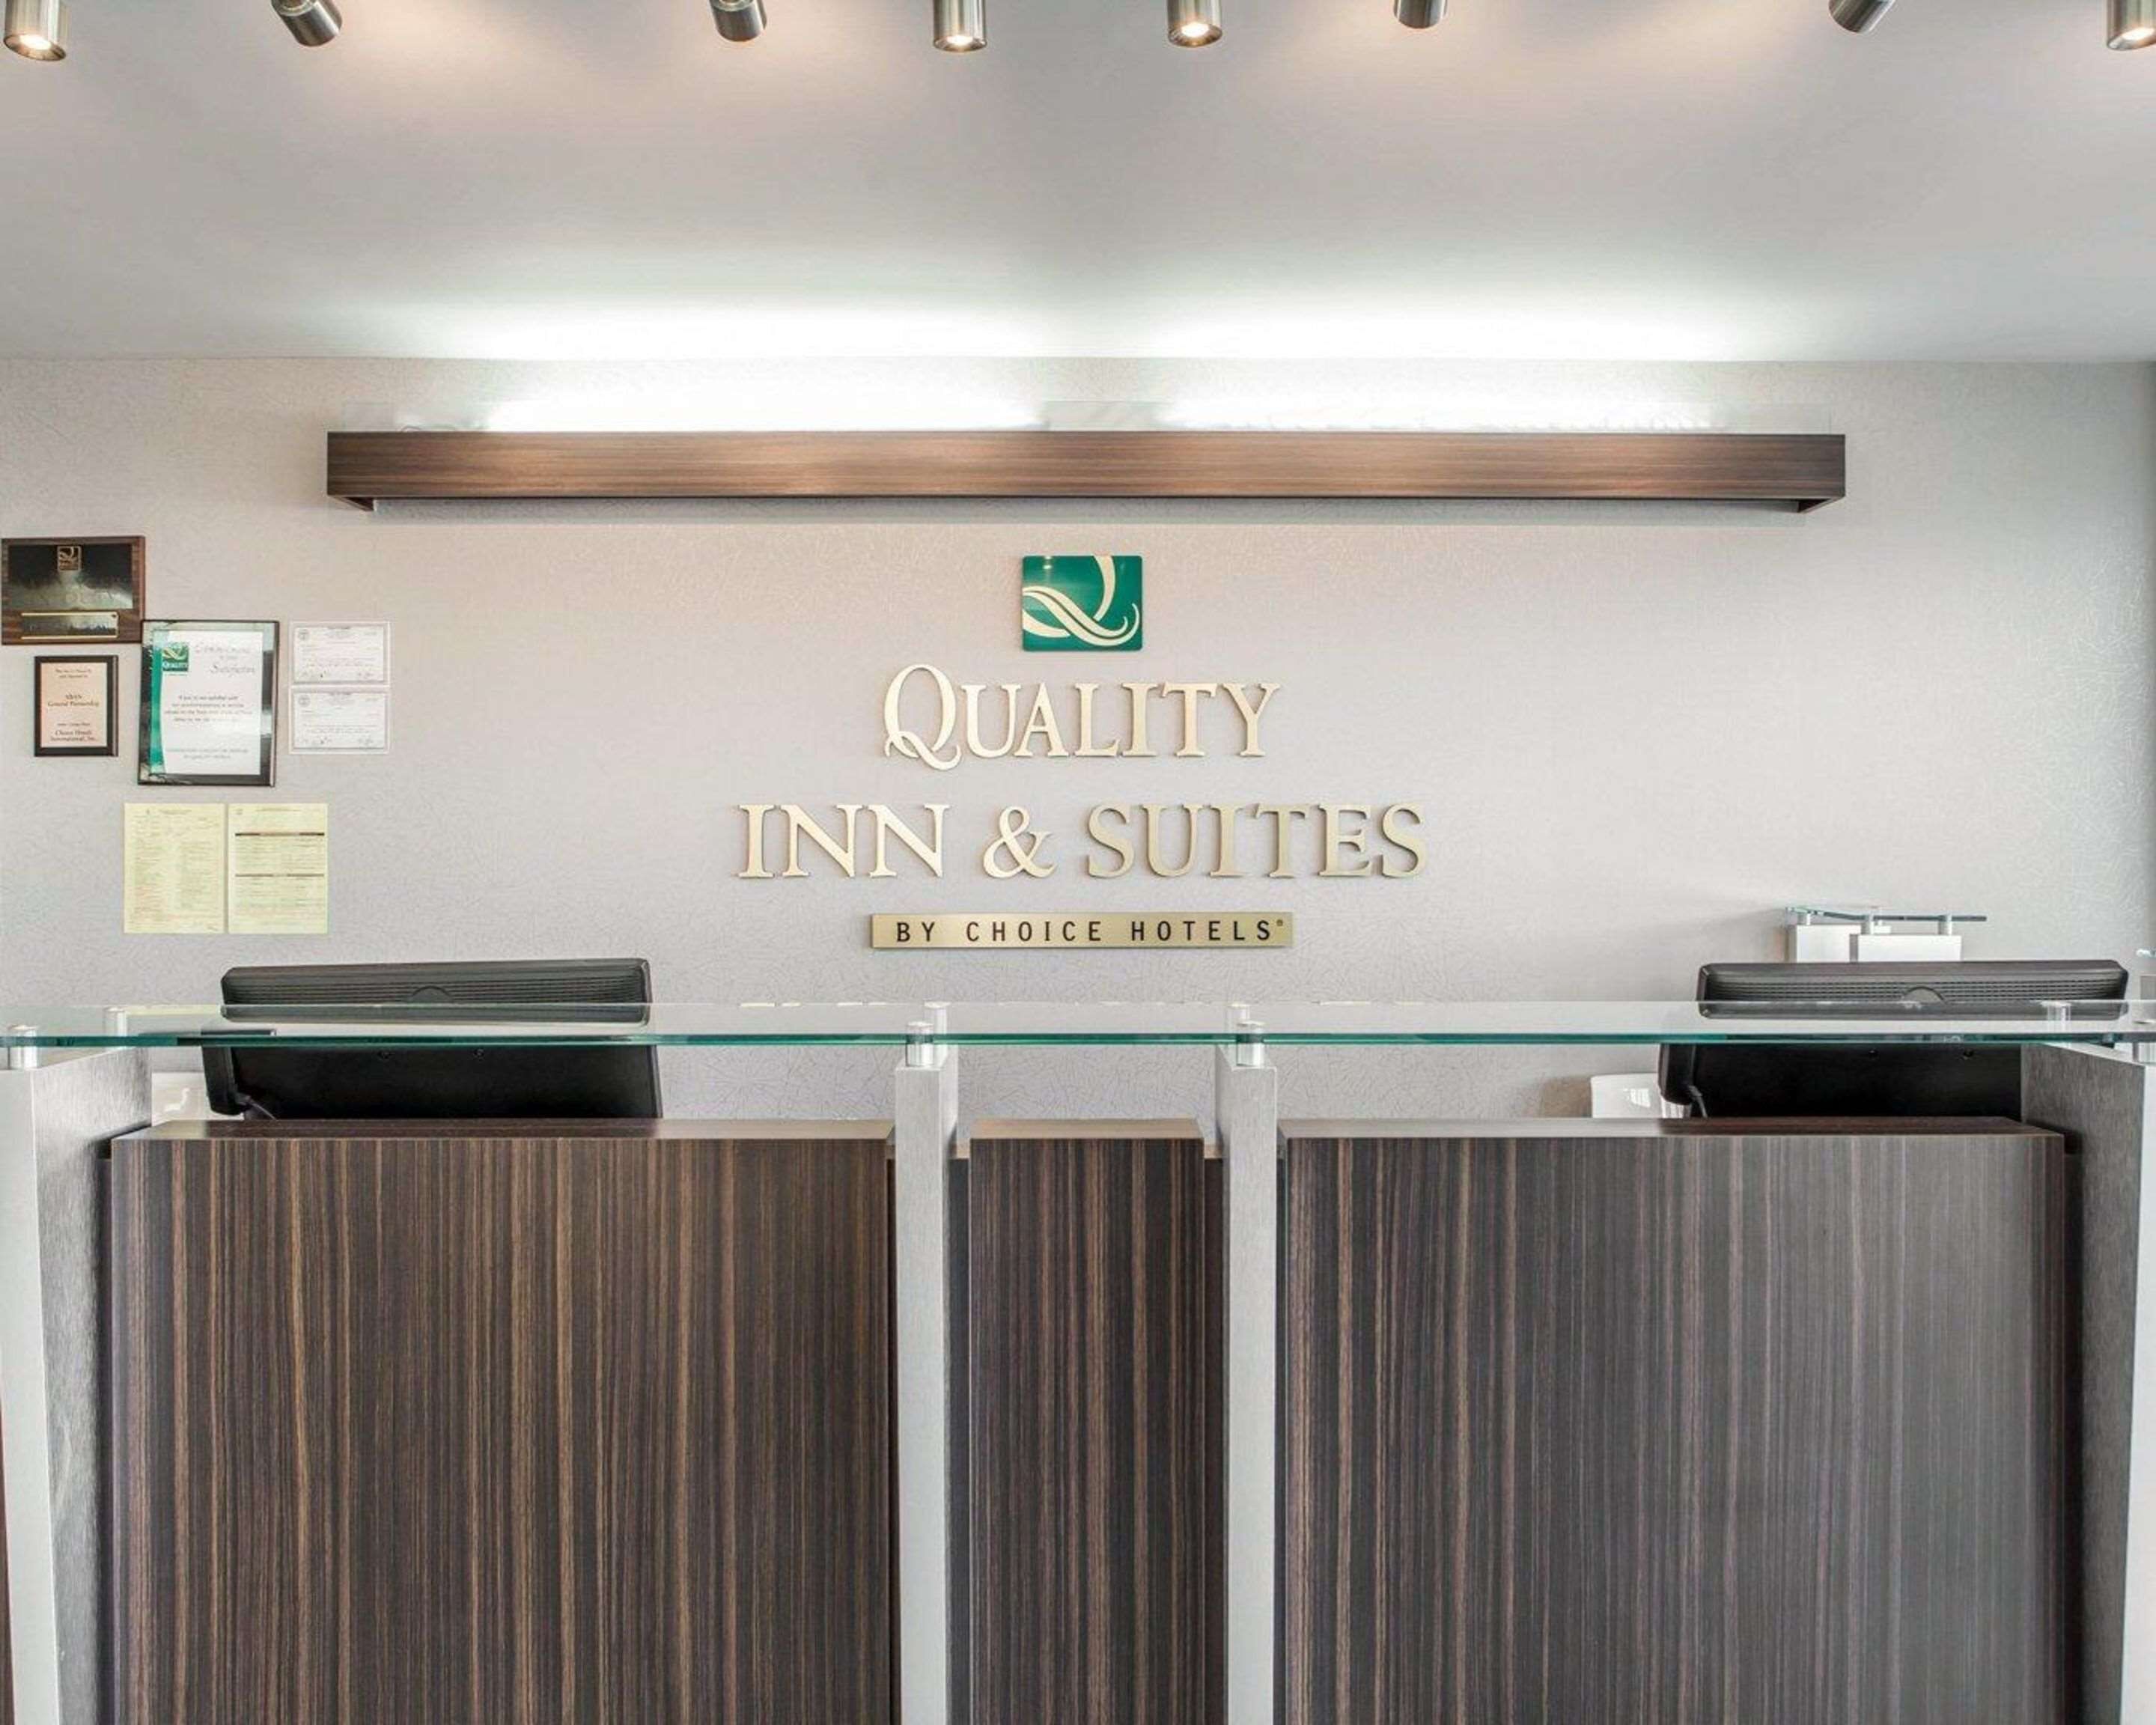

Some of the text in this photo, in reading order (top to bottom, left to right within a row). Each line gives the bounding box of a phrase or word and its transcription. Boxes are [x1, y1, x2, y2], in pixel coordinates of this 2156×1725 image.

[883, 663, 1281, 771] QUALITY
[736, 802, 1428, 879] INN & SUITES
[896, 922, 936, 942] BY
[966, 922, 1102, 942] CHOICE
